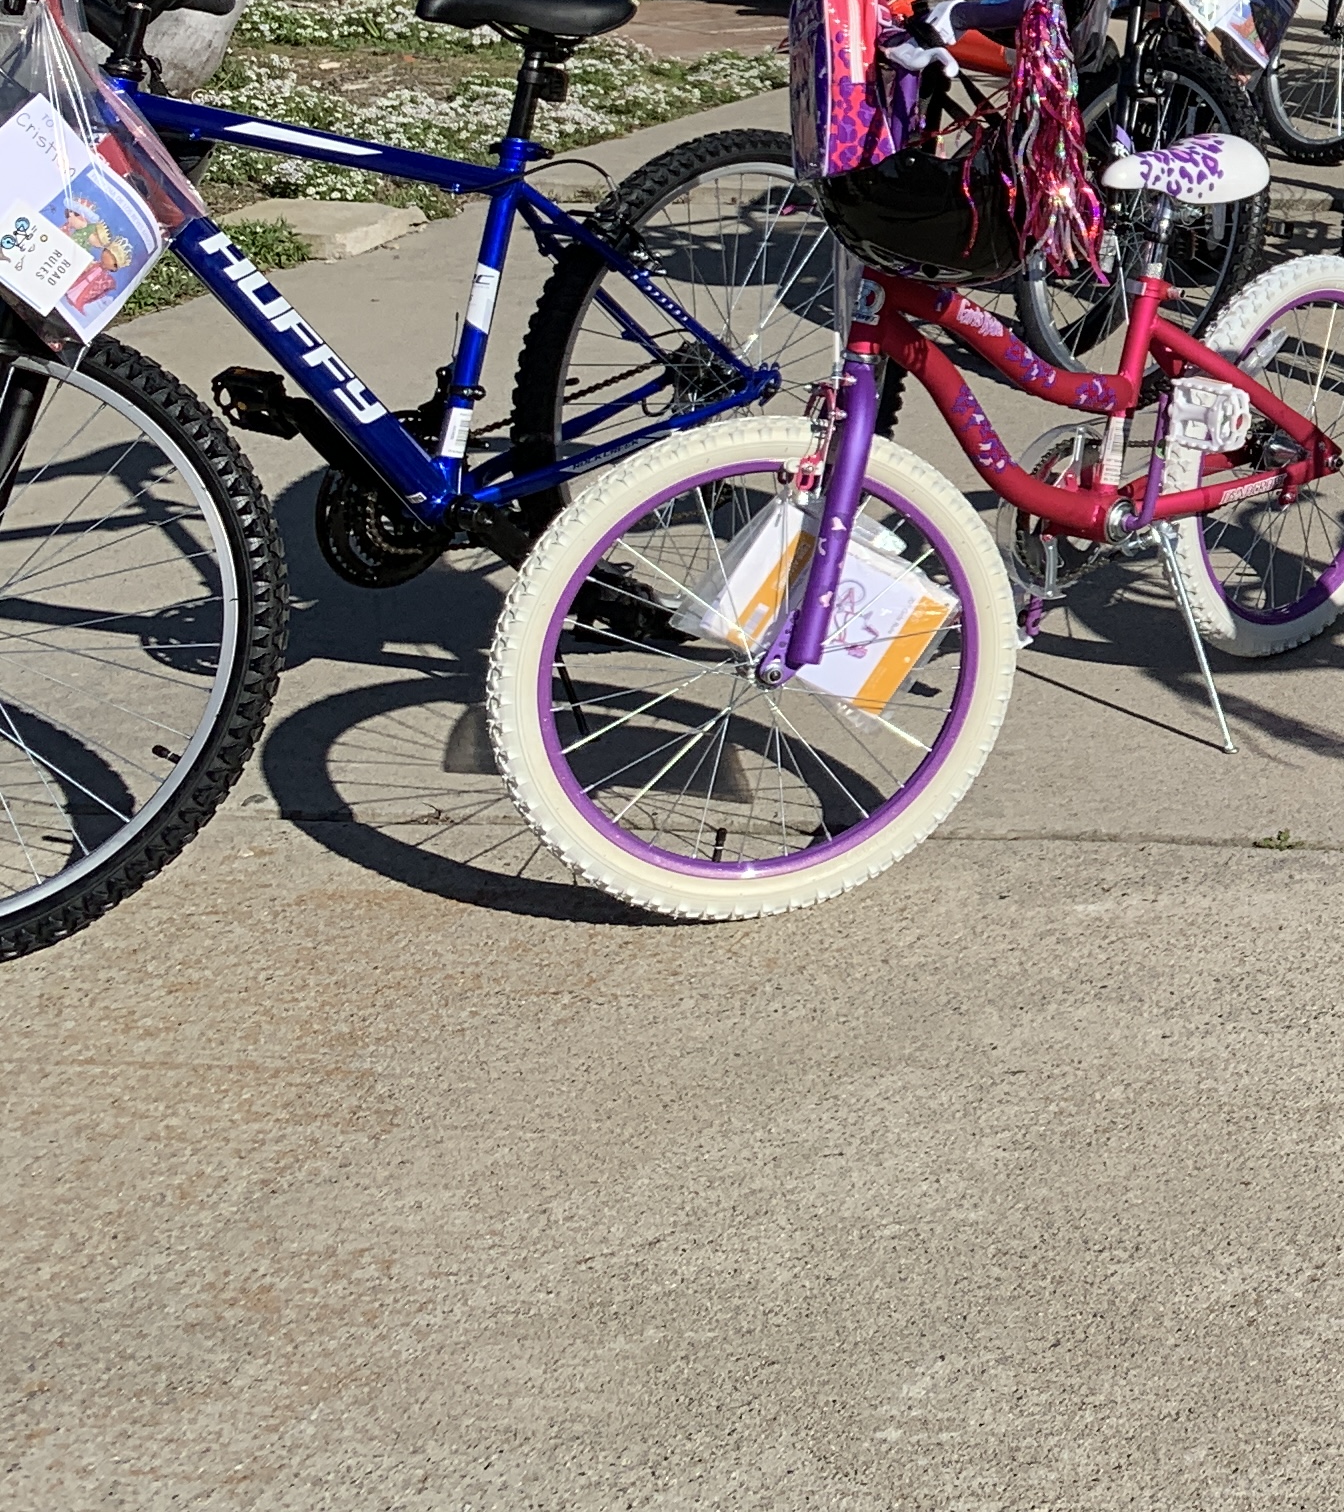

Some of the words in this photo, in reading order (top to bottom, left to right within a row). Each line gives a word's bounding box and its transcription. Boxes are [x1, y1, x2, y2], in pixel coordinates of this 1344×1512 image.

[41, 112, 55, 128] TO
[15, 112, 76, 178] Cristin
[35, 248, 63, 281] RULES
[47, 258, 72, 286] ROAD
[199, 231, 388, 424] HUFFY
